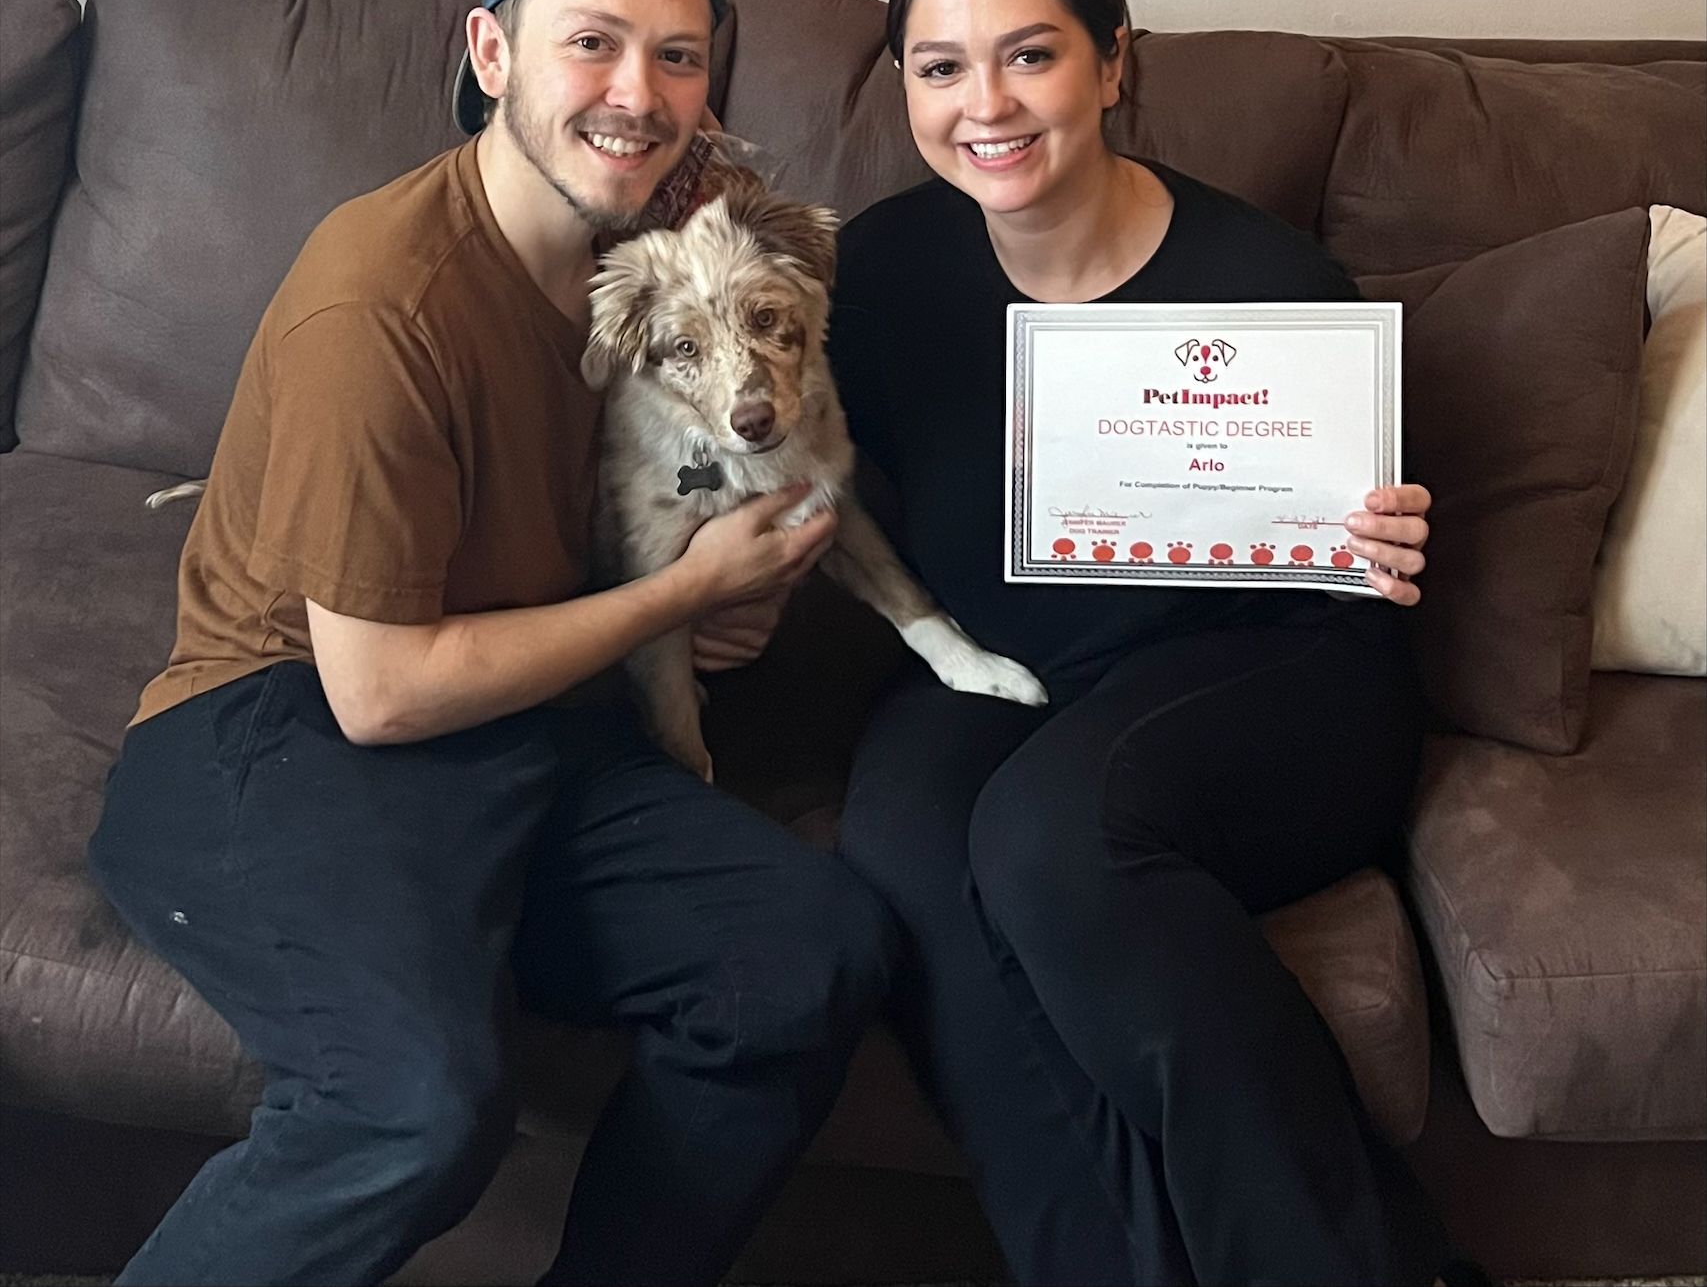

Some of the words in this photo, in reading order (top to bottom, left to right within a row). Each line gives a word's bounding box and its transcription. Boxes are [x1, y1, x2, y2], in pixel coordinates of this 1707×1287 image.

[1143, 389, 1269, 409] PetImpact!
[1098, 419, 1219, 436] DOGTASTIC
[1226, 421, 1313, 437] DEGREE
[1196, 442, 1217, 450] given
[1189, 458, 1225, 472] Arlo
[1119, 480, 1132, 488] For
[1134, 481, 1180, 489] Completion
[1182, 482, 1191, 490] of
[1258, 485, 1293, 493] Program
